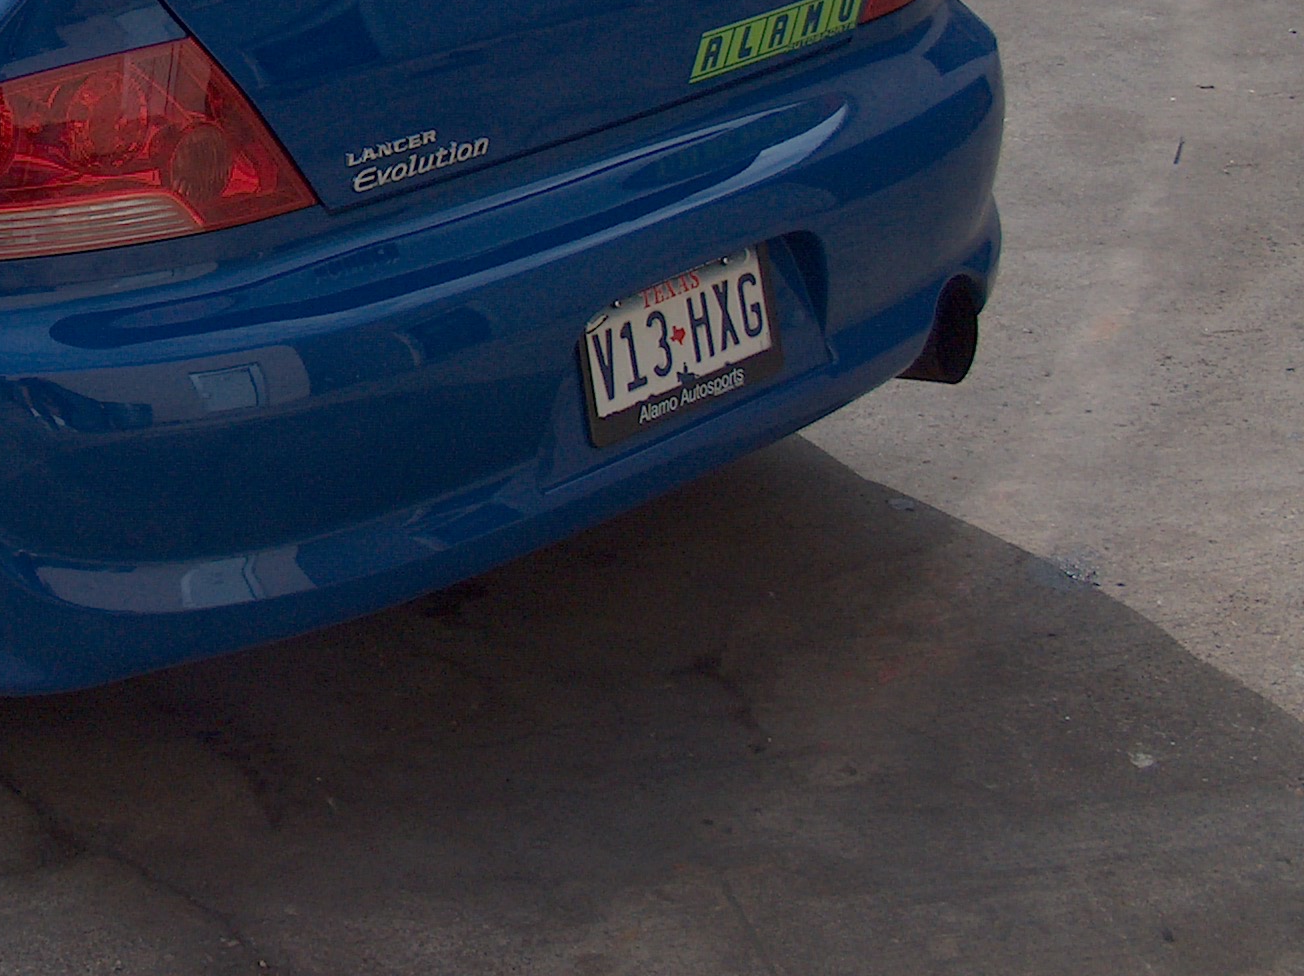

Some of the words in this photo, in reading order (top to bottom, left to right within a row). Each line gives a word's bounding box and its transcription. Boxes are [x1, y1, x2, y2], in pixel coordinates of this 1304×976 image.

[346, 129, 437, 167] LANCER
[352, 137, 490, 193] Evolution
[638, 271, 702, 309] TEXAS
[592, 310, 673, 401] V13
[685, 272, 763, 364] HXG
[638, 395, 678, 424] Alamo
[680, 367, 745, 407] Autosports
